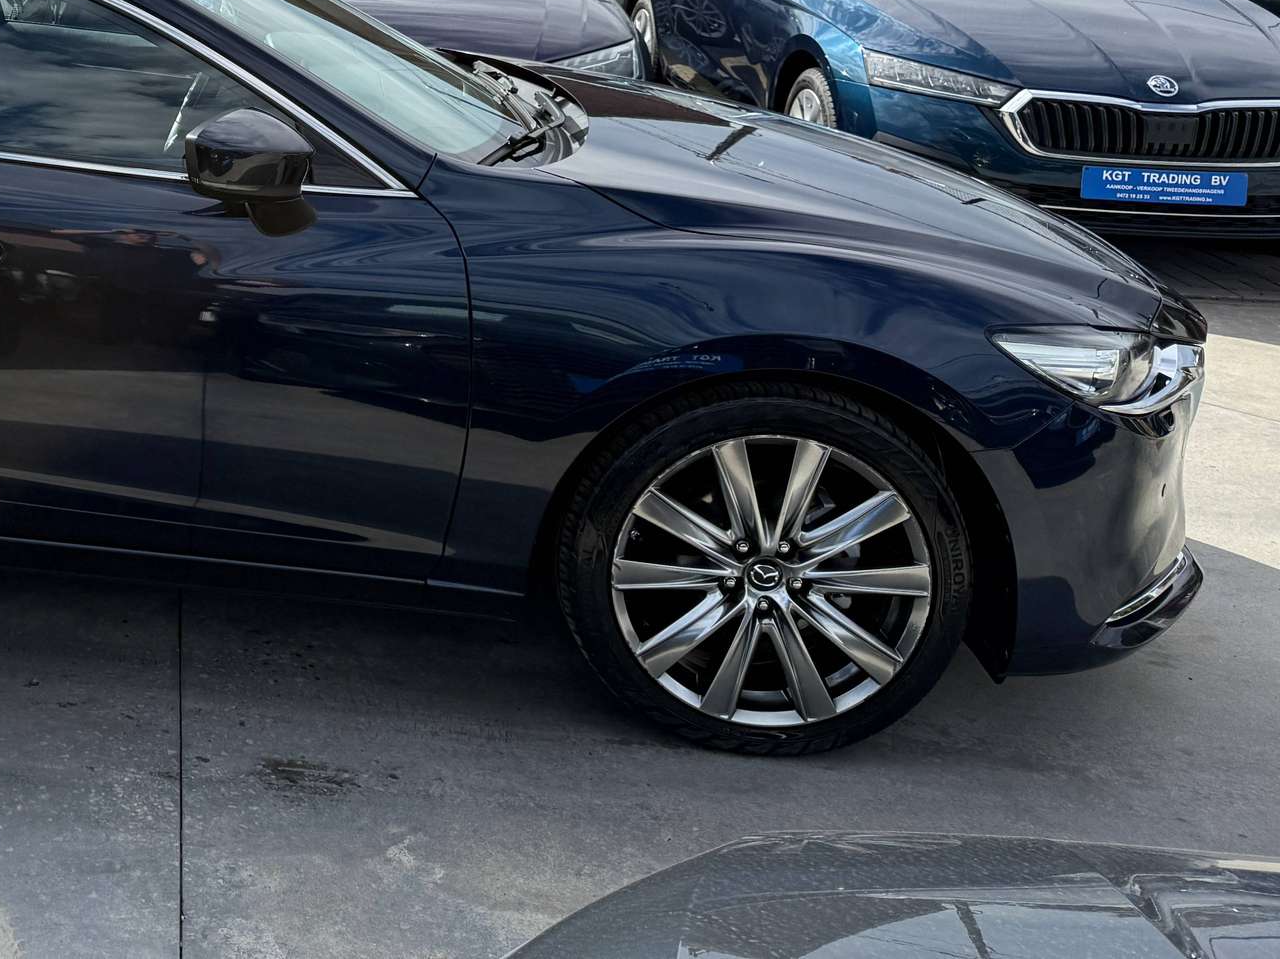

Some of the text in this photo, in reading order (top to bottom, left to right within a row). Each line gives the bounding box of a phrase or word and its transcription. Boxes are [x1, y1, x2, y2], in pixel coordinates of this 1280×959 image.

[1102, 170, 1229, 186] KGT TRADING BV
